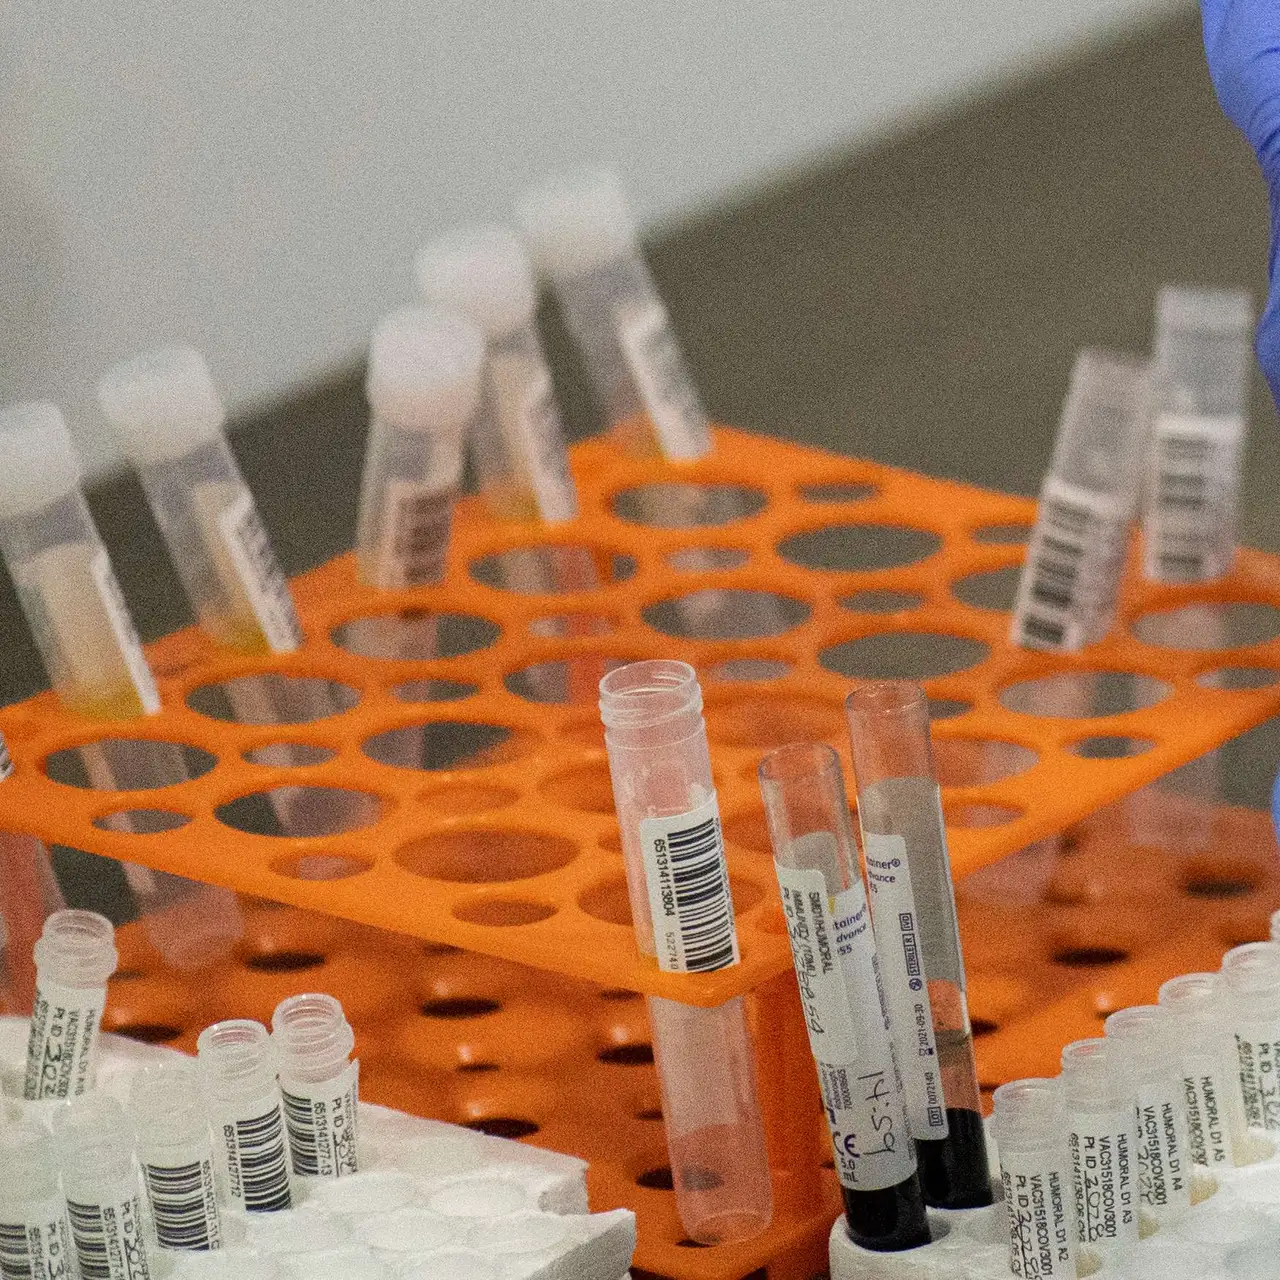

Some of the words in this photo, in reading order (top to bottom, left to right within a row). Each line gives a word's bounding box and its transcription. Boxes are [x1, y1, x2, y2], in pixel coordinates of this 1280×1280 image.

[654, 838, 676, 917] 651314113804
[50, 1024, 62, 1038] ID
[913, 1003, 929, 1048] 2021-09-30
[1201, 1076, 1220, 1129] HUMORAL
[333, 1114, 344, 1128] ID
[930, 1107, 942, 1126] LOT
[1161, 1102, 1177, 1158] HUMORAL
[1210, 1131, 1222, 1145] D1
[1085, 1155, 1097, 1169] ID
[1117, 1133, 1130, 1190] HUMORAL
[1143, 1105, 1167, 1206] VAC31518COV3001
[1169, 1160, 1180, 1175] D1
[1100, 1135, 1117, 1238] VAC31518COV3001
[1171, 1176, 1183, 1191] A4
[1018, 1194, 1029, 1209] ID
[1048, 1171, 1064, 1228] HUMORAL
[1121, 1191, 1132, 1206] D1
[1030, 1174, 1053, 1276] VAC31518COV3001
[1122, 1209, 1133, 1225] A3
[1055, 1228, 1067, 1244] D1
[1058, 1246, 1069, 1262] A2
